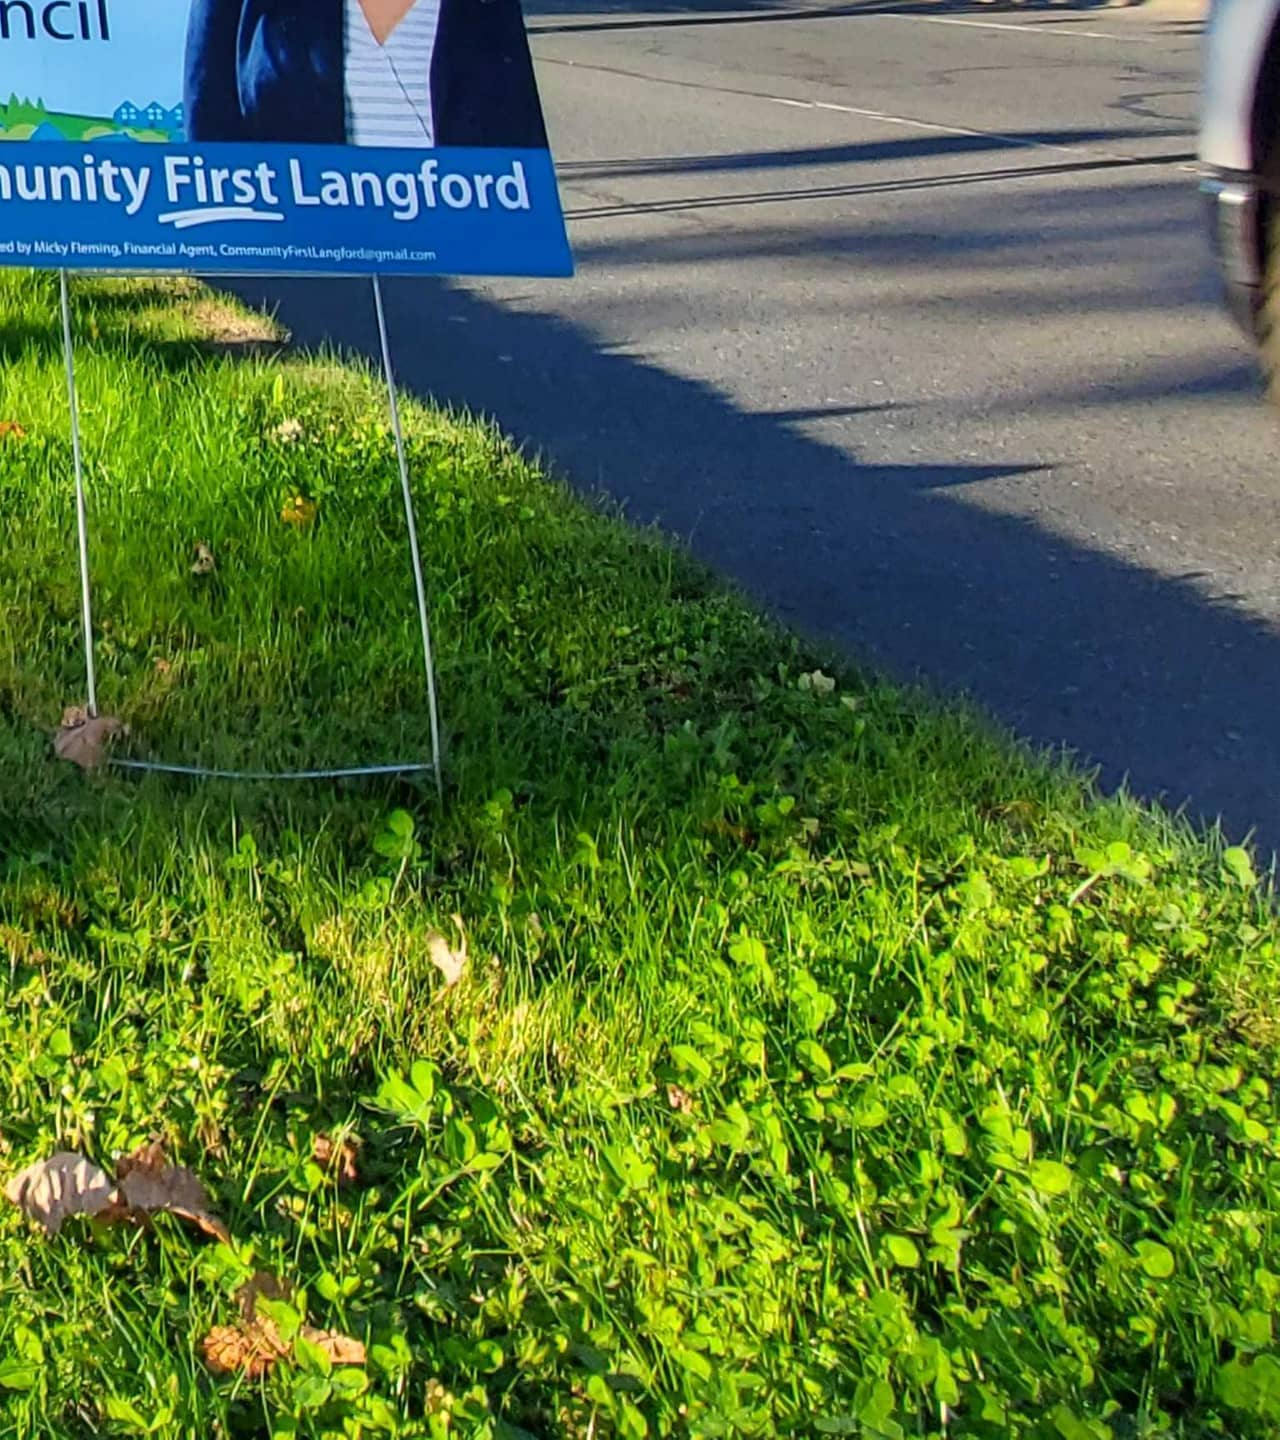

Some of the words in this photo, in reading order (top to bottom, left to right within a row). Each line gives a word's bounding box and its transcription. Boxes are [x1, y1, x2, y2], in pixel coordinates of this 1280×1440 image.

[166, 154, 280, 205] First
[292, 159, 530, 220] Langford
[17, 240, 31, 255] by
[34, 240, 68, 256] Micky
[71, 241, 121, 257] Fleming,
[124, 242, 176, 254] Financial
[179, 243, 217, 258] Agent,
